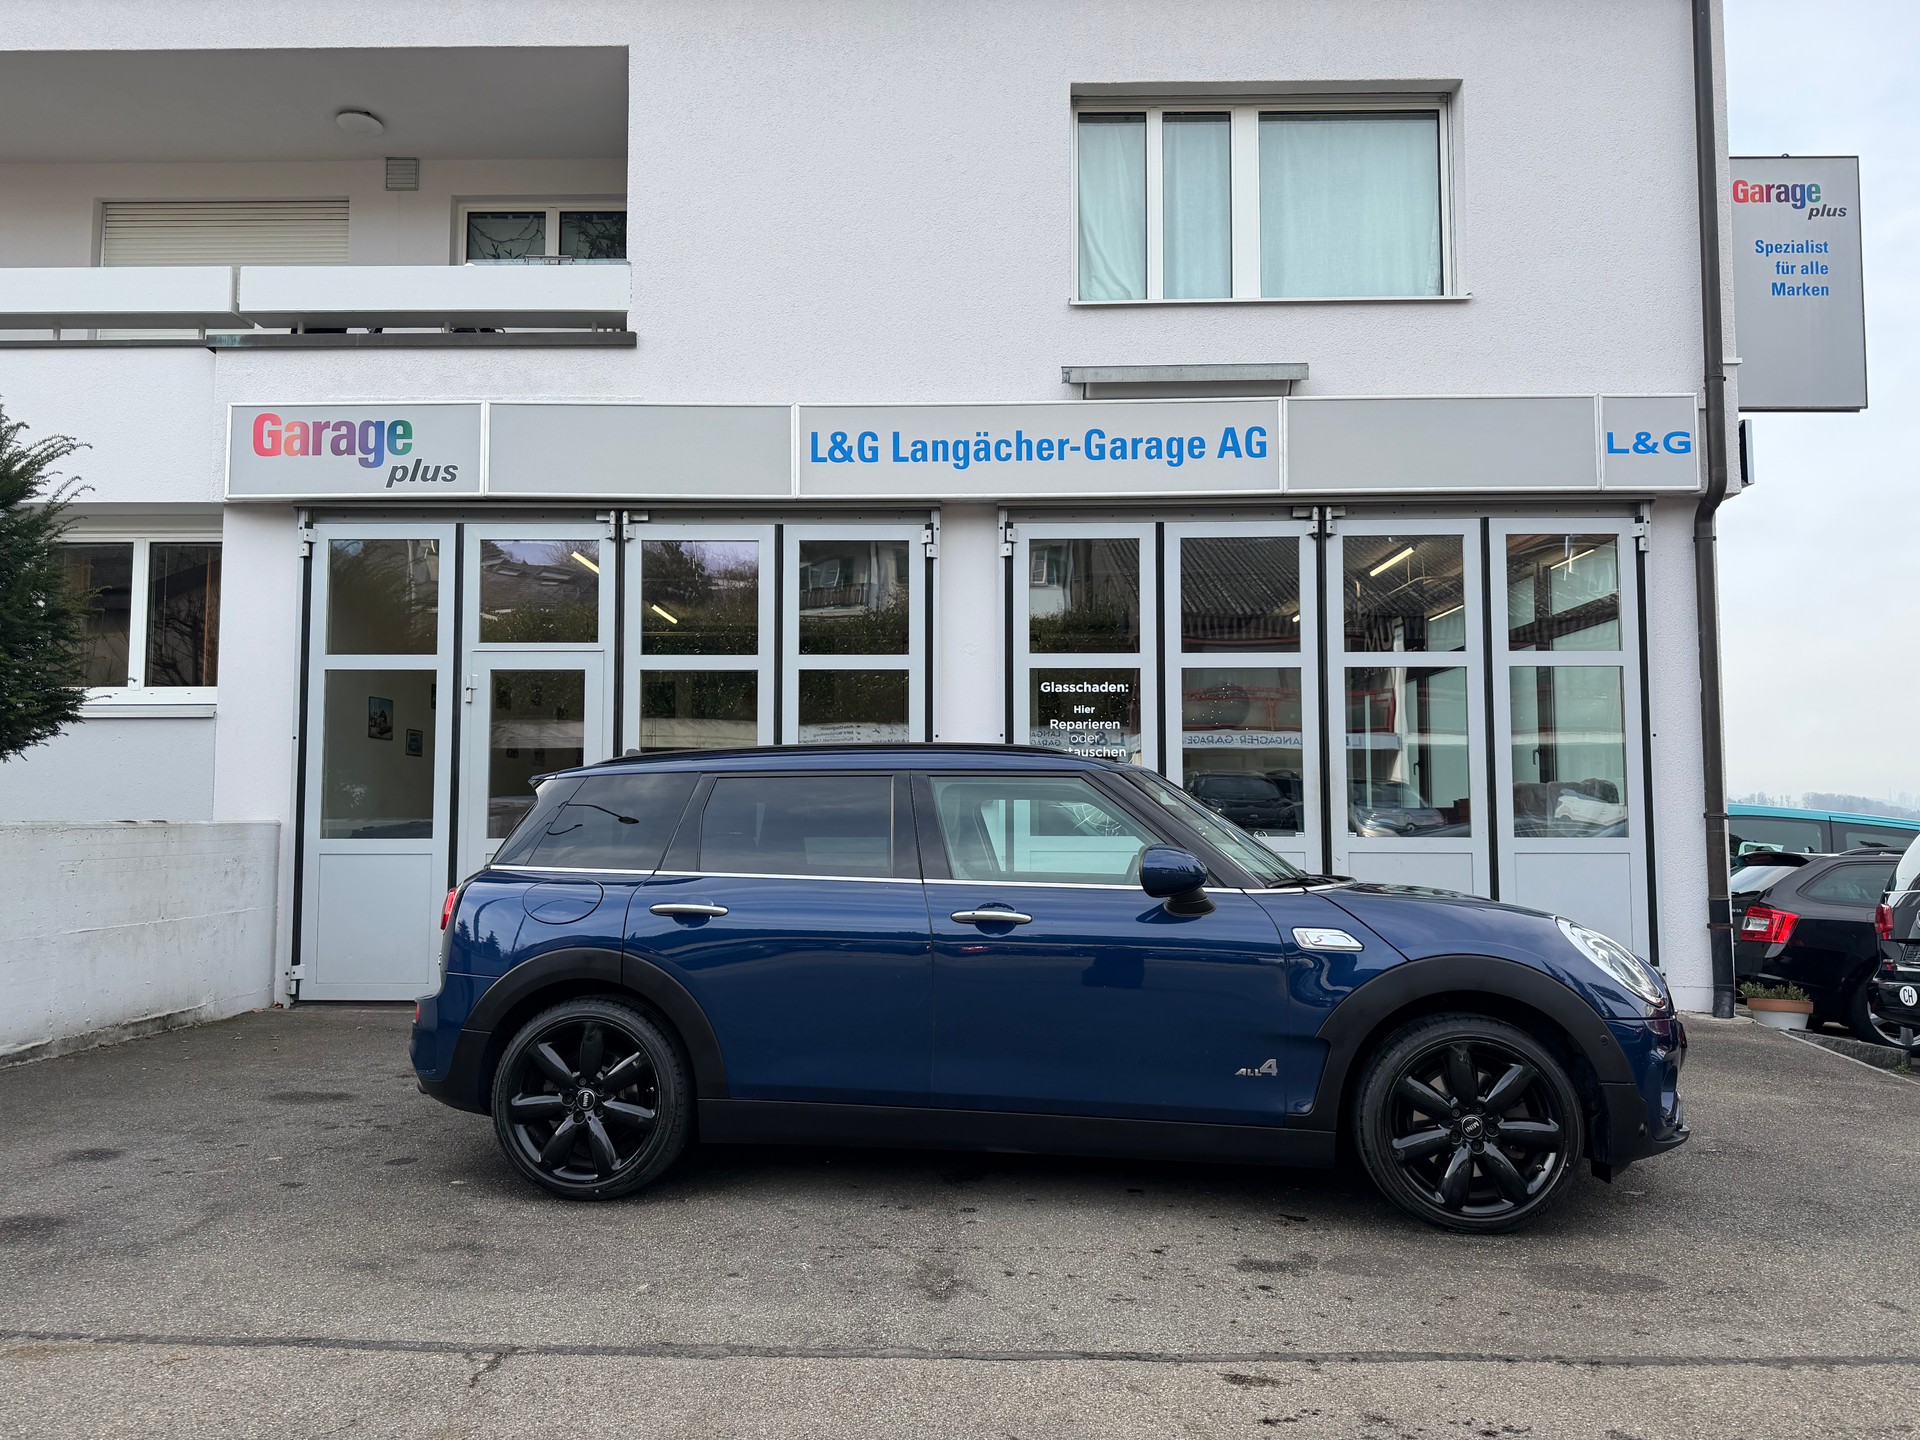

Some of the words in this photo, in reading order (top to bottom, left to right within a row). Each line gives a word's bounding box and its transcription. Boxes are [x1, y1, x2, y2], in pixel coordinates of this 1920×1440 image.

[1732, 179, 1821, 210] Garage
[1808, 204, 1847, 220] plus
[1755, 239, 1829, 257] Spezialist
[1775, 261, 1796, 275] für
[1800, 261, 1829, 275] alle
[1771, 282, 1830, 296] Marken
[252, 412, 413, 469] Garage
[810, 431, 880, 463] L&G
[892, 428, 1206, 470] Langächer-Garage
[1217, 426, 1267, 459] AG
[1606, 430, 1692, 455] L&G
[385, 458, 459, 489] plus
[1040, 682, 1129, 693] Glasschaden:
[1073, 705, 1096, 714] Hier
[1049, 719, 1121, 731] Reparieren
[1070, 733, 1099, 743] oder
[1902, 988, 1914, 1004] CH
[1464, 1121, 1480, 1133] MINI
